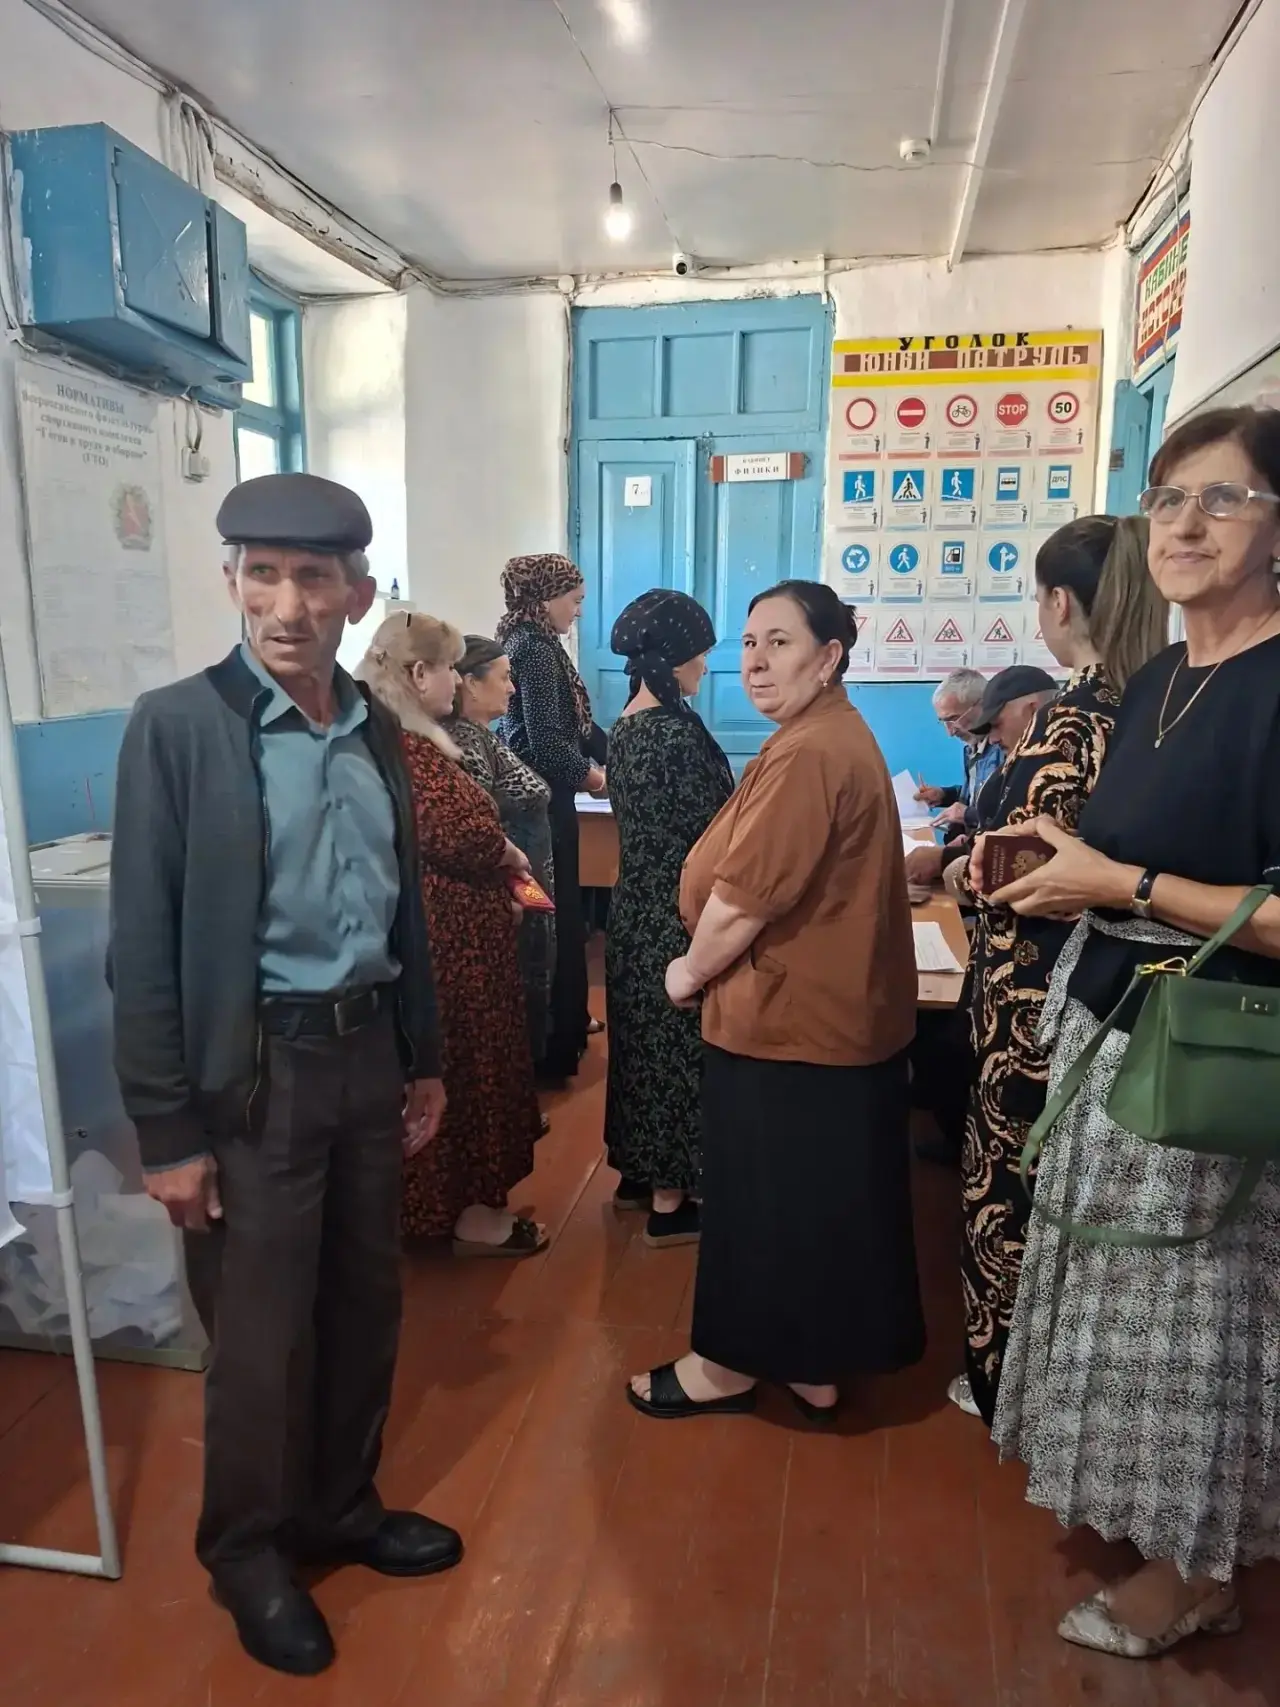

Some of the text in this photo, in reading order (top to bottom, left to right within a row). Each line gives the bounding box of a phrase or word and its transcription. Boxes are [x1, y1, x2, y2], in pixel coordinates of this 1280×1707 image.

[898, 332, 1029, 351] УГОЛОК
[957, 345, 1082, 369] ПАТРУЛЬ
[56, 383, 125, 415] НОРМАТИВЫ
[998, 403, 1027, 416] STOP
[1055, 401, 1072, 414] 50
[734, 466, 779, 475] ФИЗИКИ
[1051, 475, 1068, 484] ДПС
